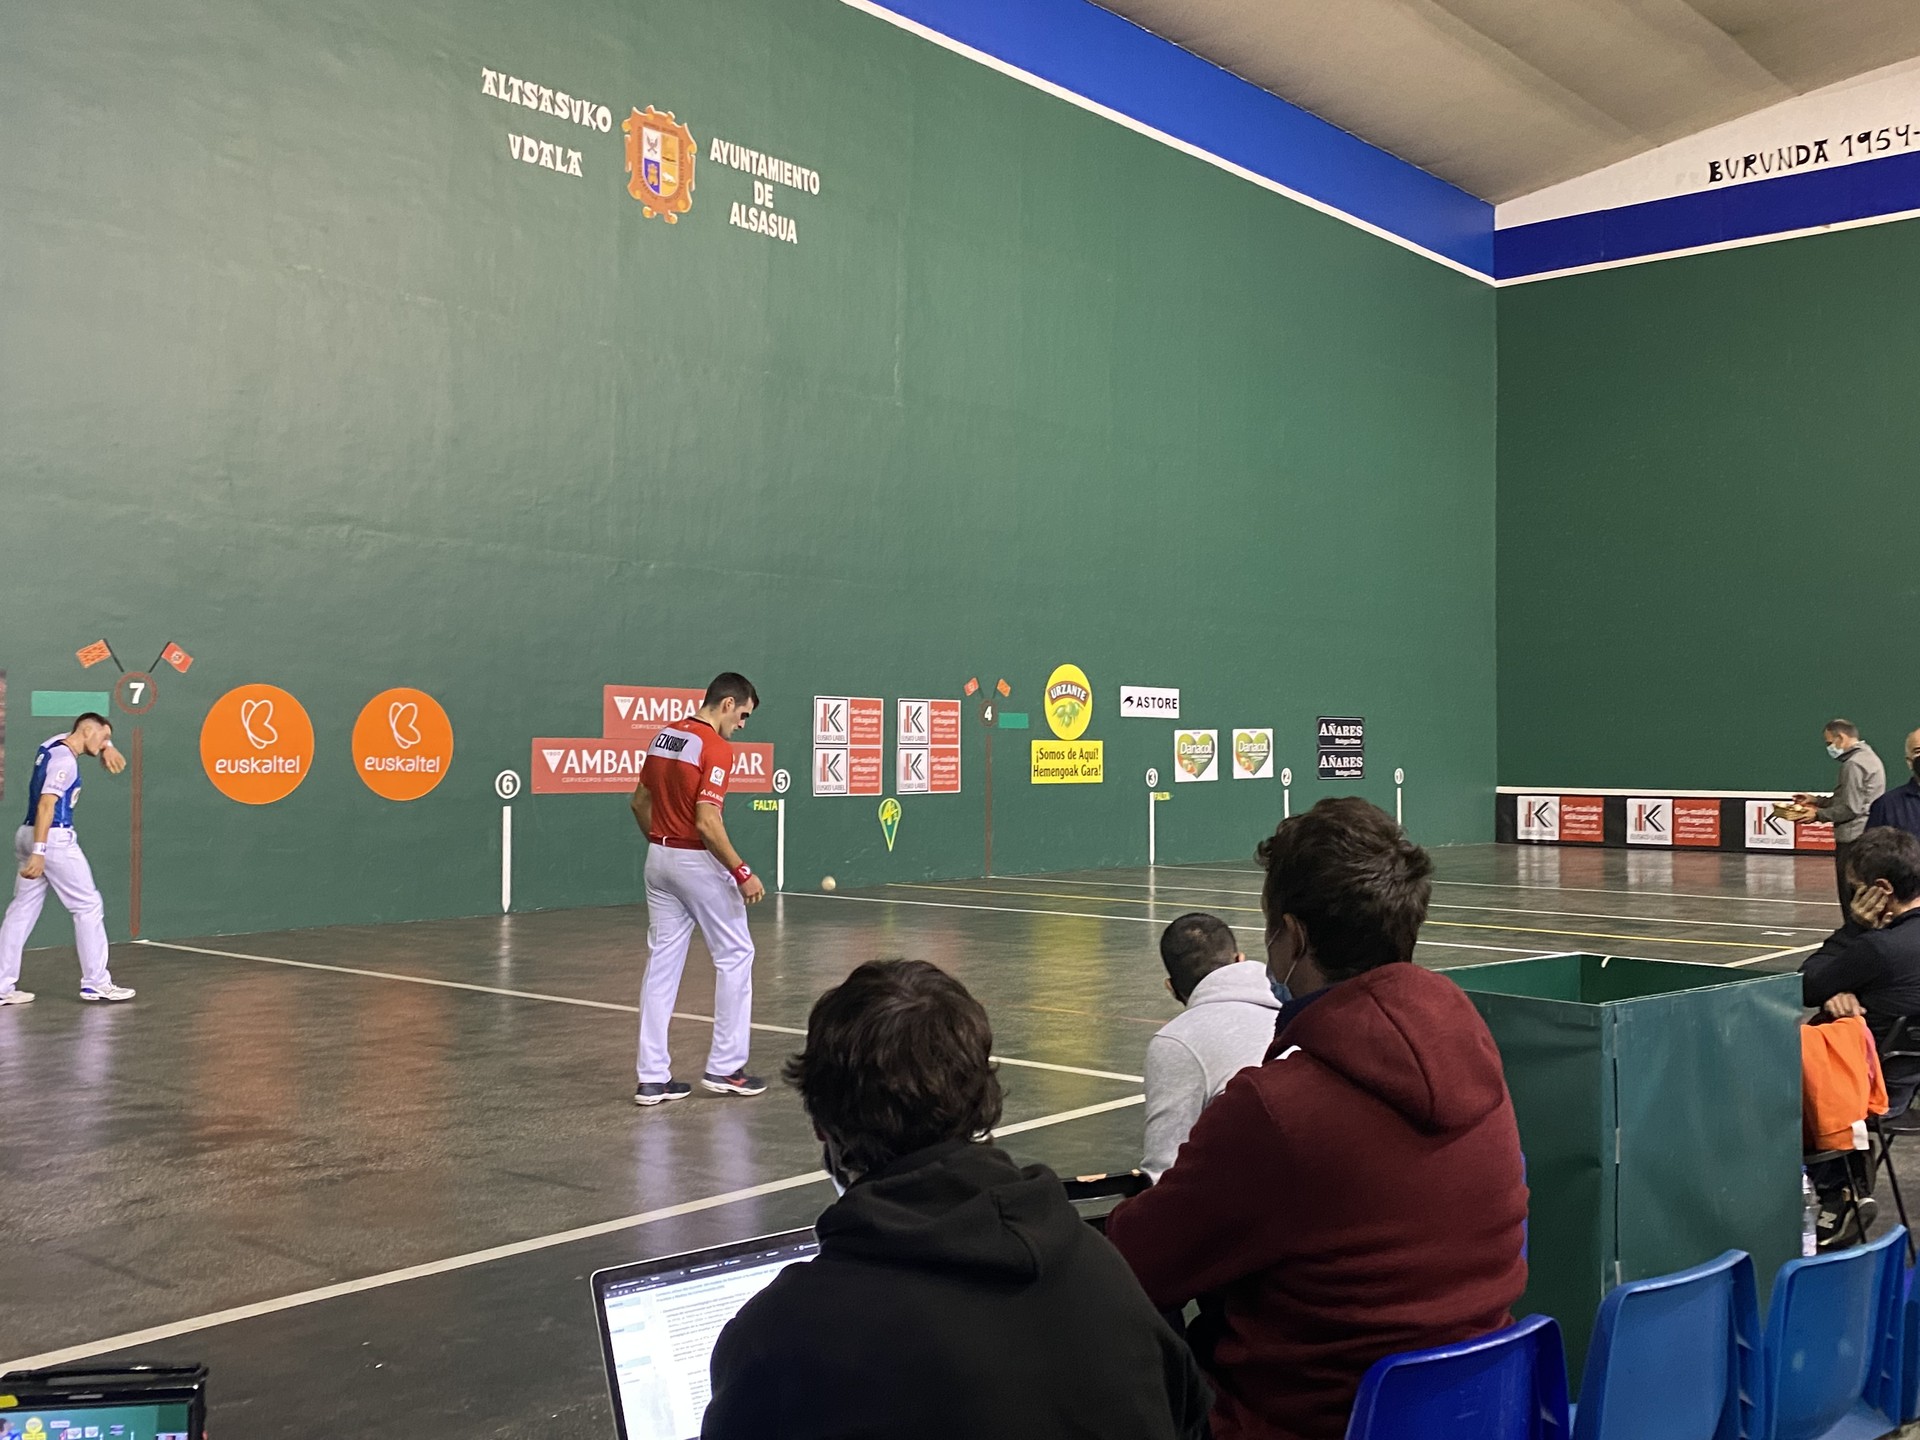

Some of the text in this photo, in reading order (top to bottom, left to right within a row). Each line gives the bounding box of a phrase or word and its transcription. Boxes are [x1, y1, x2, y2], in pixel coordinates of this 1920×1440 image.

[709, 137, 821, 196] AYUNTAMIENTO
[753, 180, 775, 210] DE
[728, 201, 798, 245] ALSASUA
[129, 682, 145, 704] 7
[1050, 683, 1087, 702] URZANTE
[1136, 696, 1178, 710] ASTORE
[984, 706, 993, 721] 4
[1319, 723, 1363, 737] AÑARES
[1036, 748, 1065, 761] ¡Somos
[1067, 747, 1077, 760] de
[1180, 740, 1214, 755] Danacol
[1237, 739, 1269, 753] Danacol
[215, 755, 301, 774] euskaltel
[363, 755, 441, 774] euskaltel
[1319, 754, 1363, 768] AÑARES
[1033, 763, 1102, 779] Hemengoak Gara!
[502, 774, 514, 794] 6
[777, 772, 787, 790] 5
[753, 800, 778, 811] FALTA
